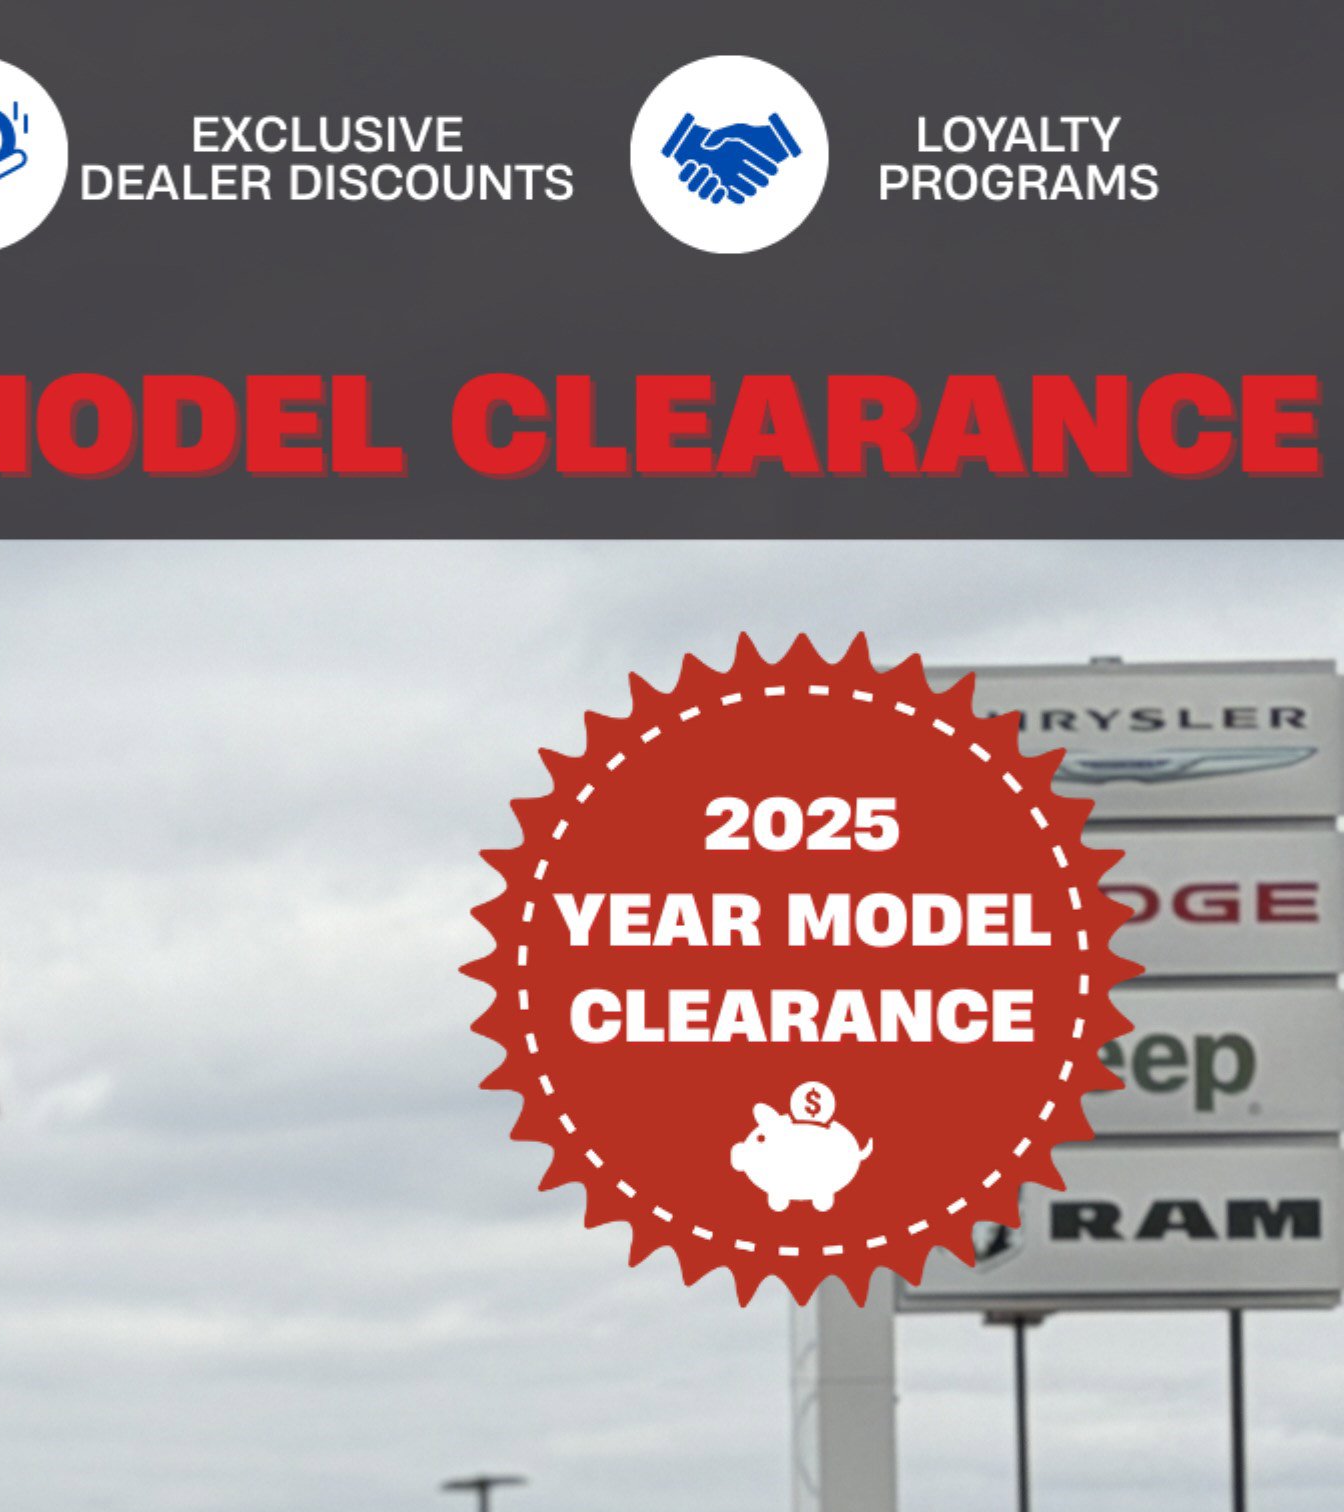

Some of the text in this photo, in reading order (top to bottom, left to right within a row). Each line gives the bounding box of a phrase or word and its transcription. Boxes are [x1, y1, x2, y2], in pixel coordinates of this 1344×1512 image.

[988, 706, 1309, 732] RYSLER
[1098, 882, 1319, 924] DGE
[1050, 1199, 1321, 1240] RAM
